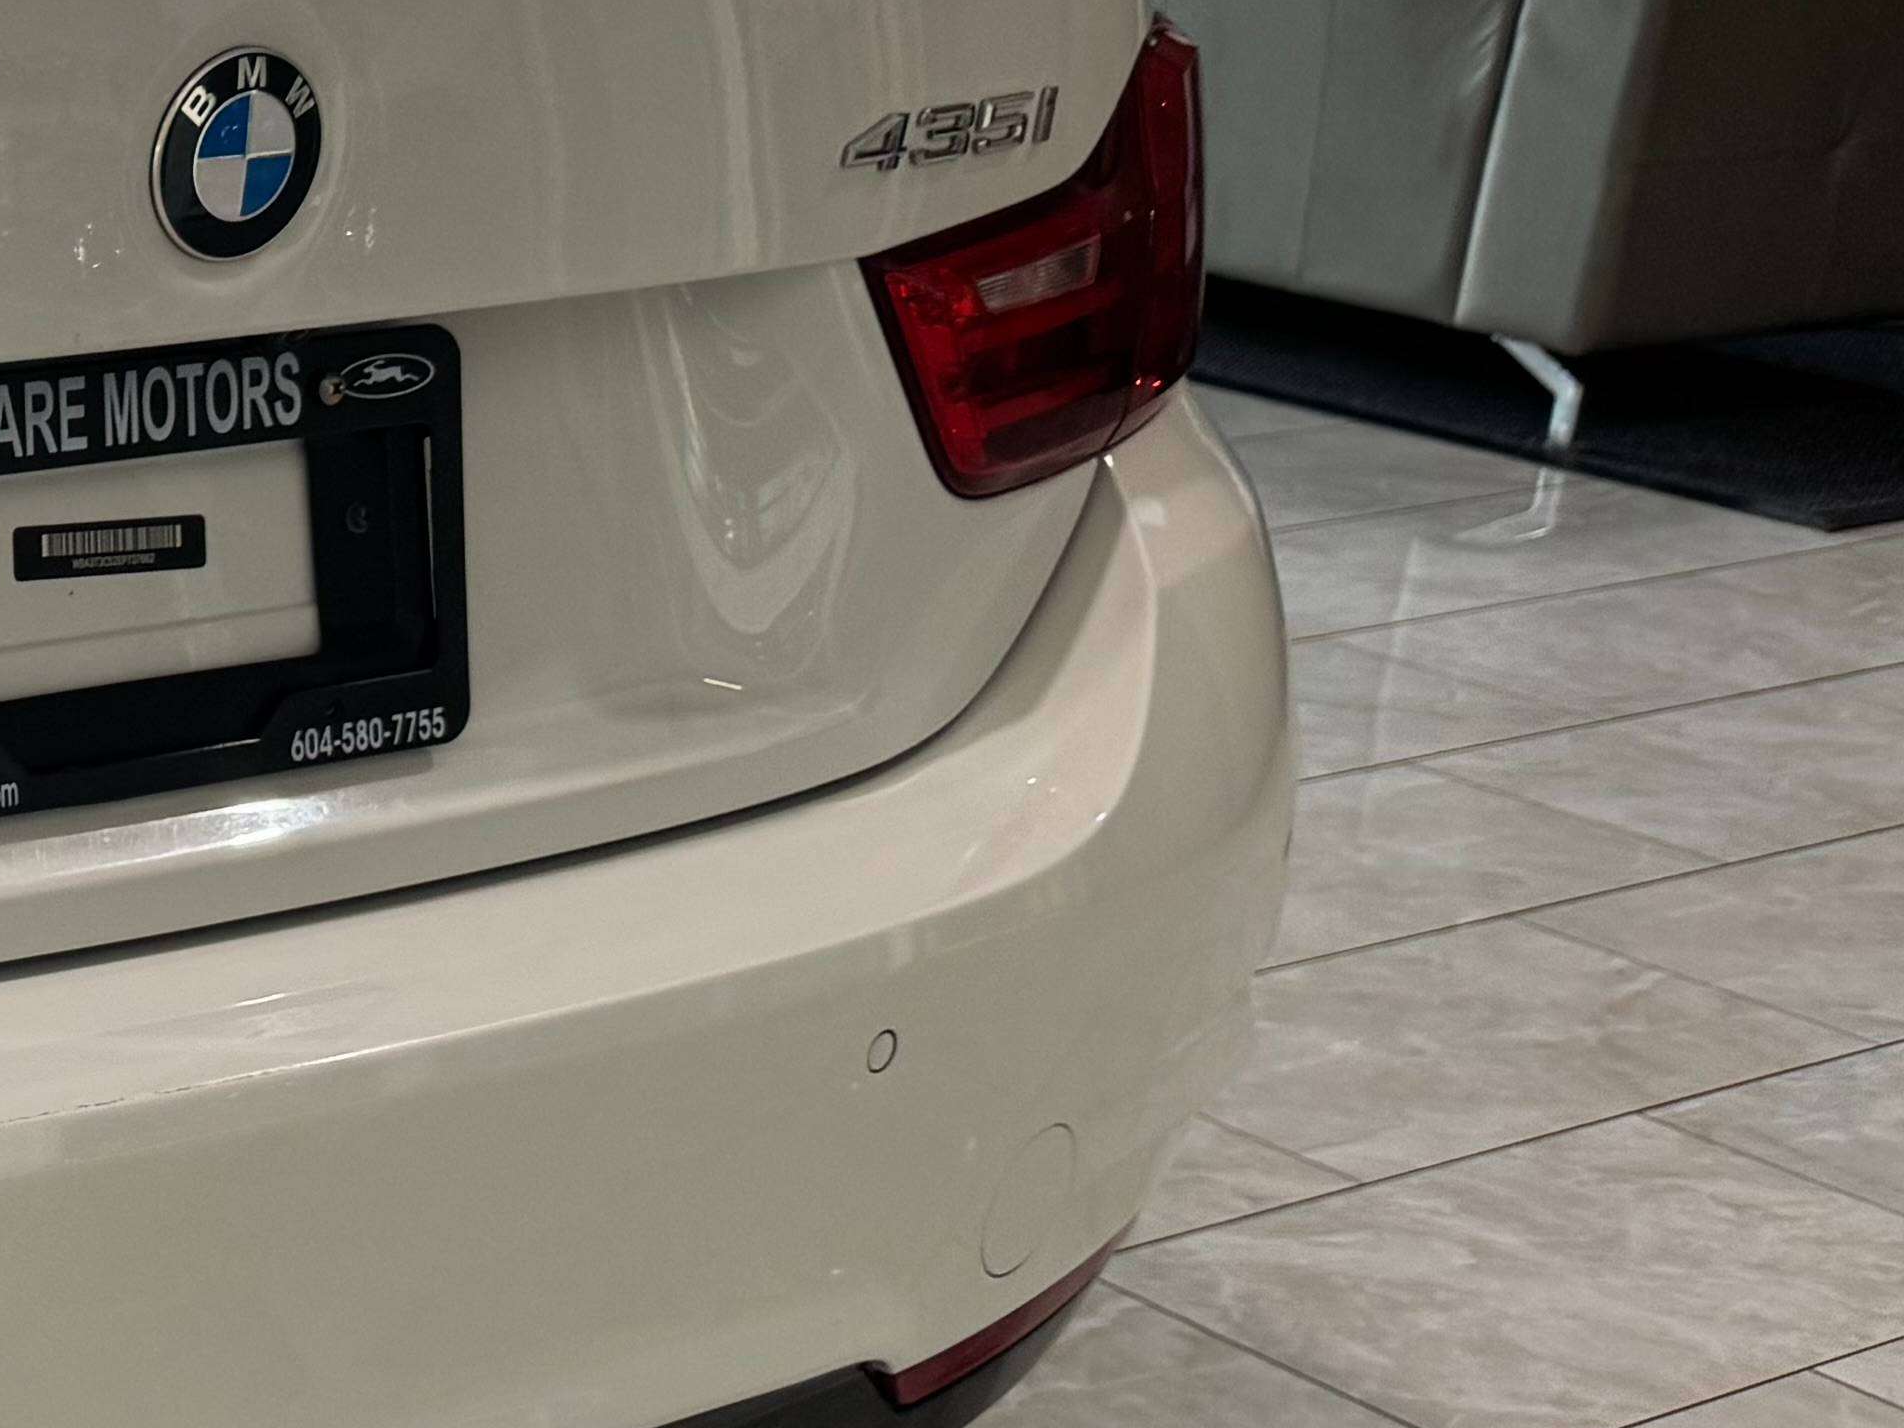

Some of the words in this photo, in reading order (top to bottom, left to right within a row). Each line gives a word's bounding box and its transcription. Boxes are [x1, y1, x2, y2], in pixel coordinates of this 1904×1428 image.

[181, 56, 316, 127] BMW
[103, 351, 302, 448] MOTORS
[291, 707, 446, 763] 604-580-7755
